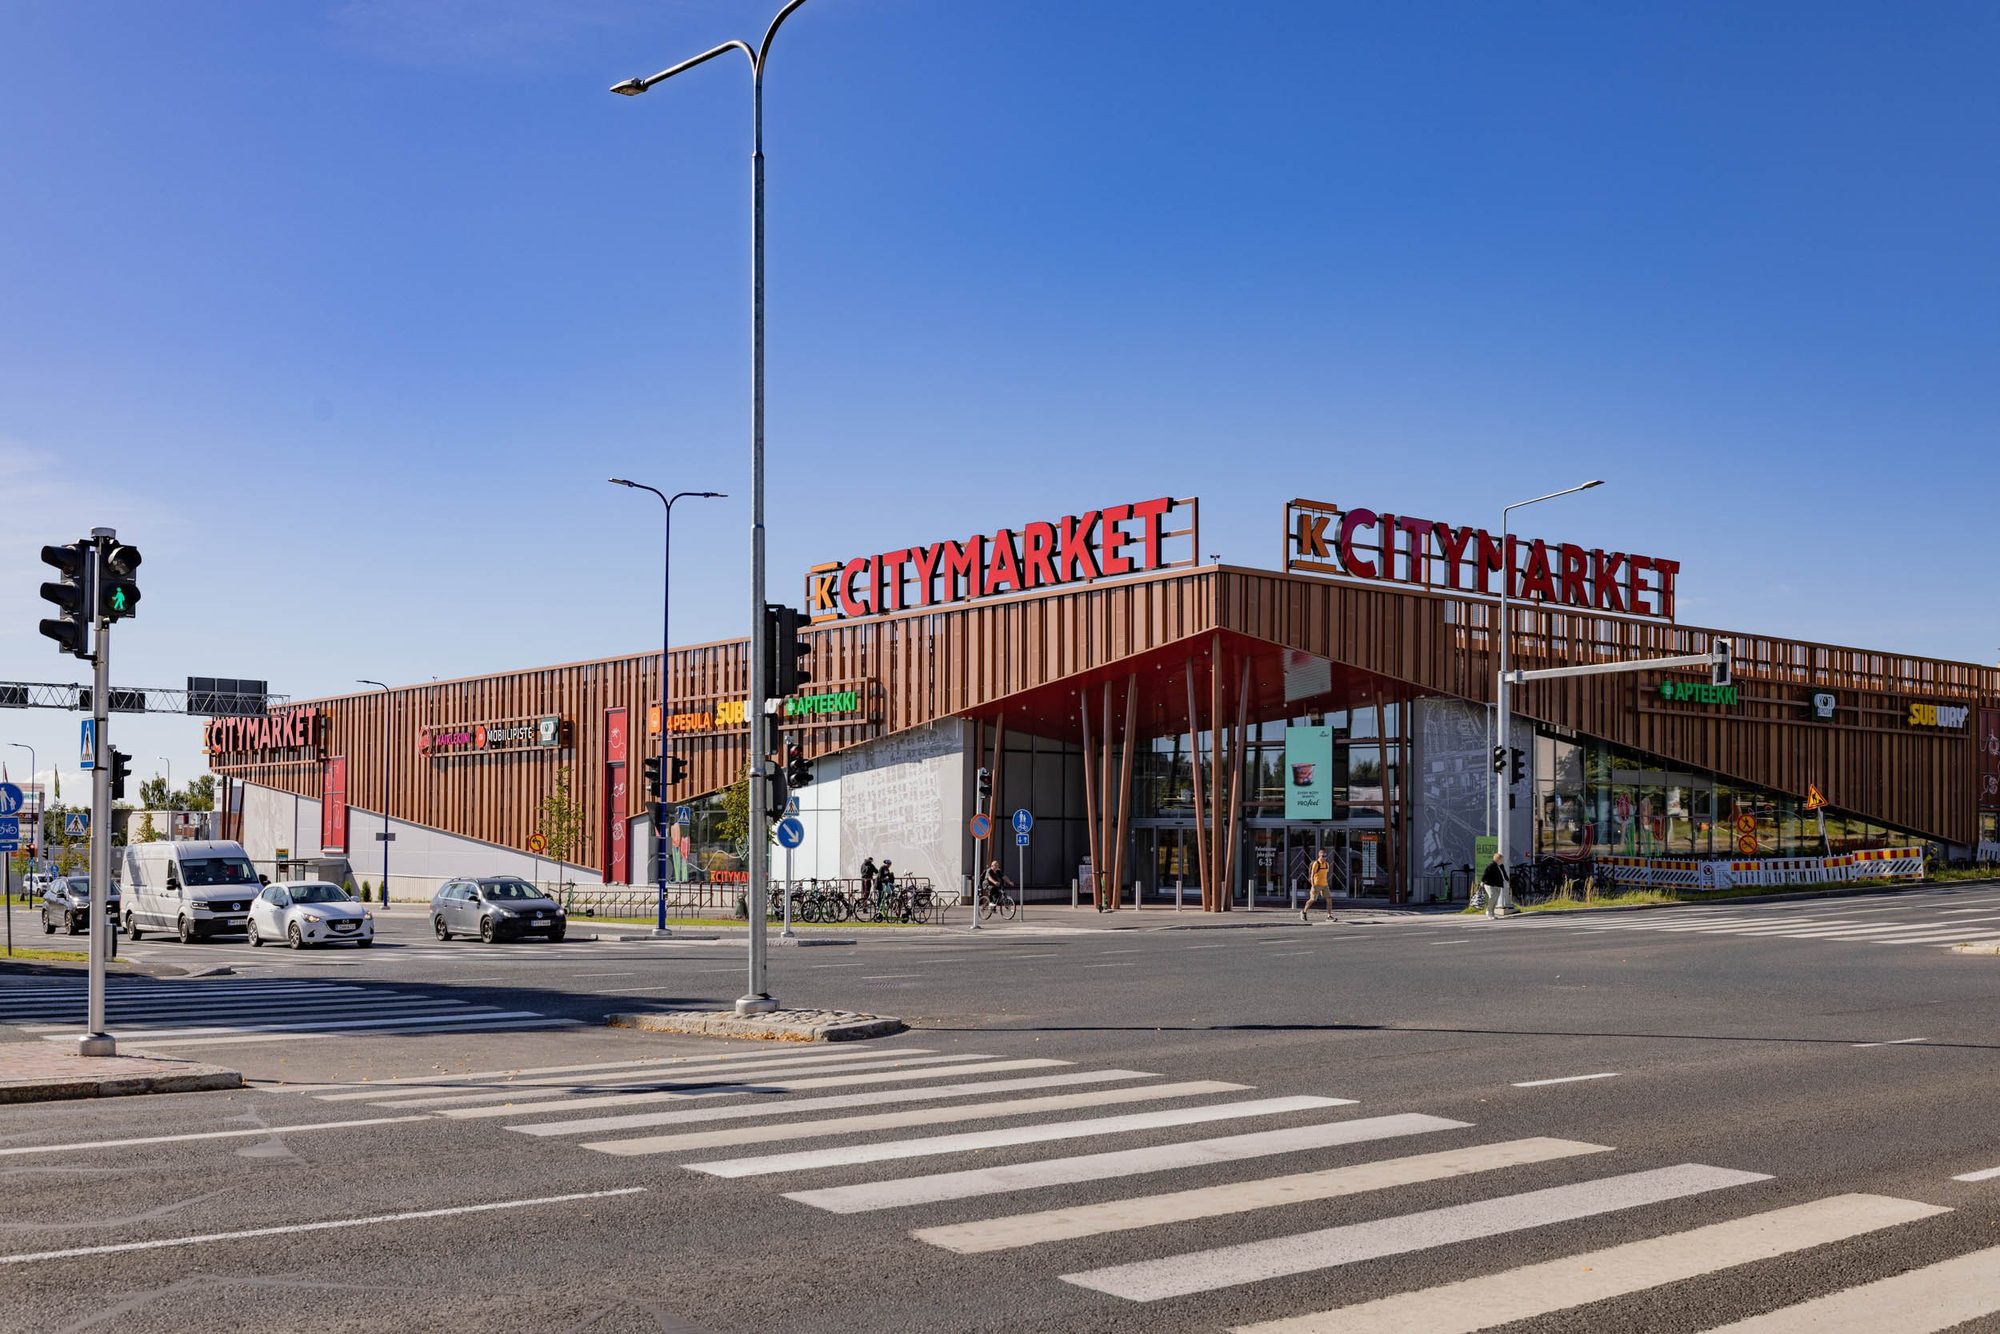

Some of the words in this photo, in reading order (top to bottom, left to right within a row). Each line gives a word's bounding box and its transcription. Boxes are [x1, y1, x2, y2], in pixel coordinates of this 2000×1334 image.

[815, 574, 836, 611] K
[840, 497, 1175, 617] CITYMARKET
[1297, 513, 1331, 558] K
[1338, 507, 1681, 617] CITYMARKET
[797, 692, 856, 716] APTEEKKI
[1675, 682, 1737, 705] APTEEKKI
[674, 712, 711, 731] PESULA
[1908, 704, 1969, 728] SUBWAY
[211, 707, 317, 752] CITYMARKET
[487, 727, 533, 742] MOBIILIPISTE
